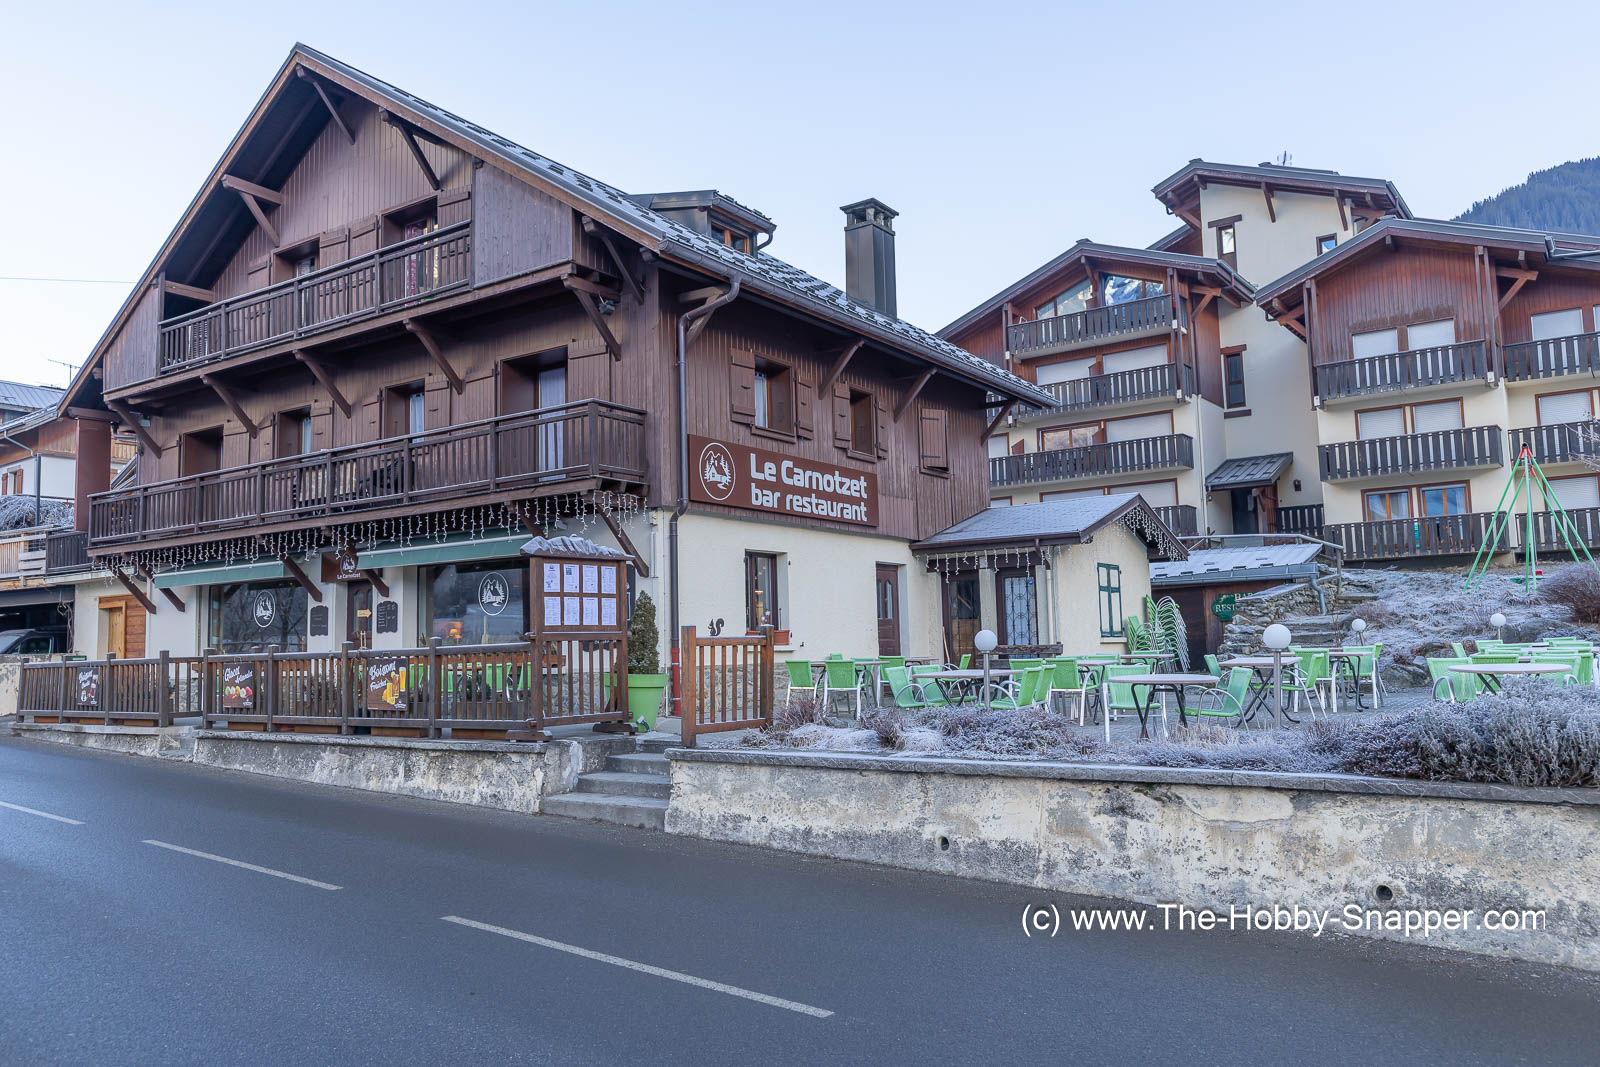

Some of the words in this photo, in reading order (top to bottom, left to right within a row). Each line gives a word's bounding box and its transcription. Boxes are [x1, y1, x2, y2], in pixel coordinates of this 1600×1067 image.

[750, 453, 776, 482] Le
[781, 460, 868, 499] Carnotzet
[750, 482, 781, 509] bar
[785, 493, 868, 522] restaurant
